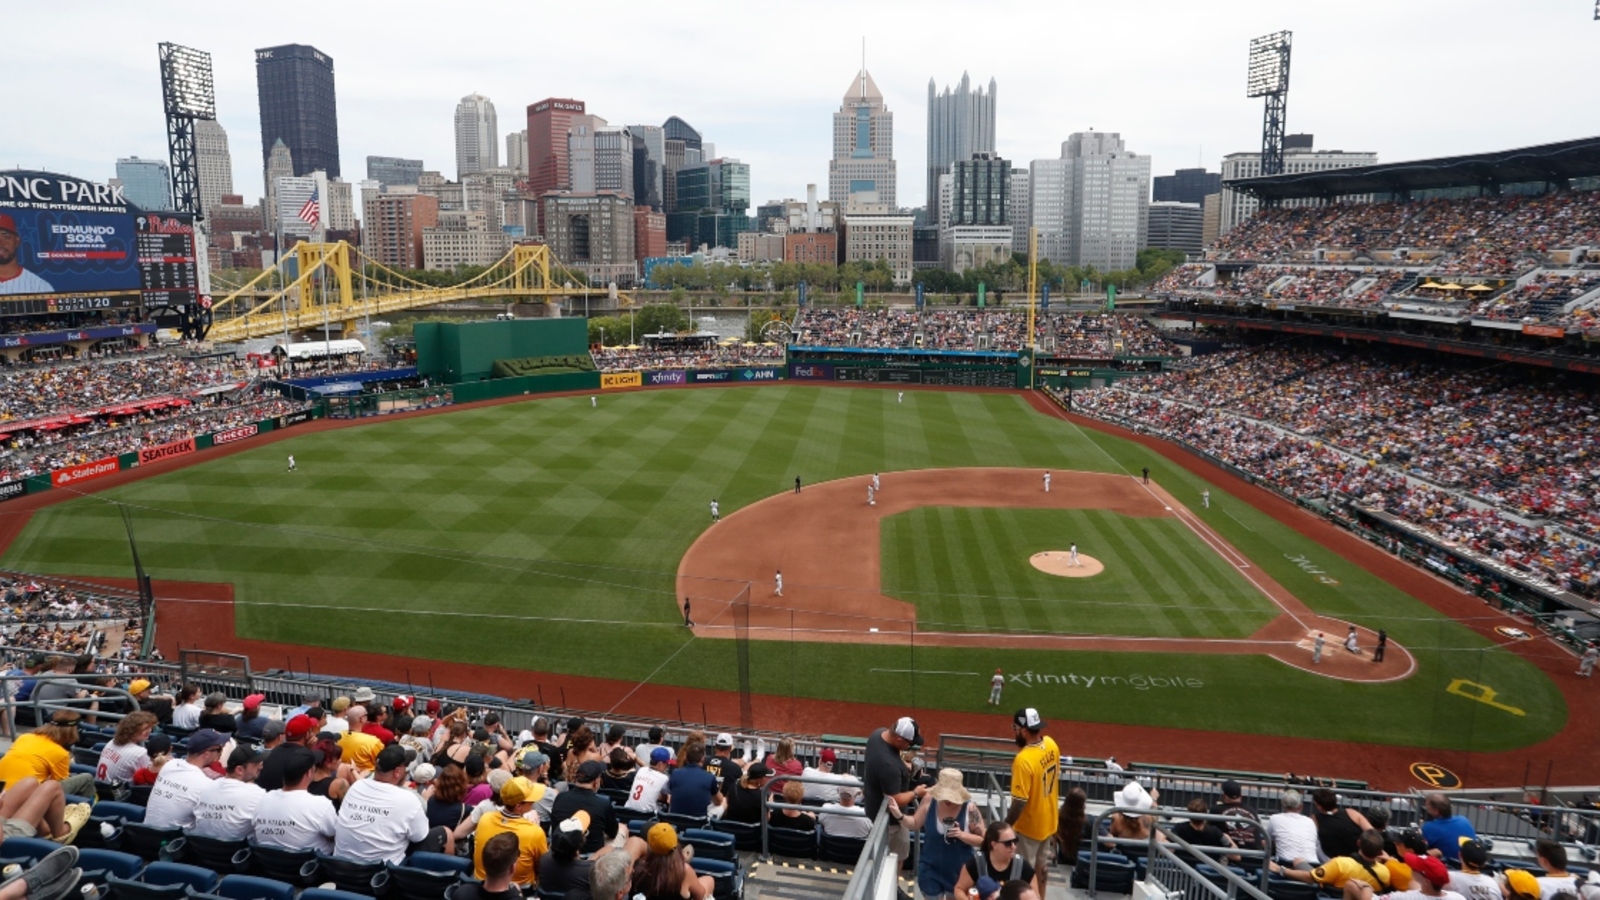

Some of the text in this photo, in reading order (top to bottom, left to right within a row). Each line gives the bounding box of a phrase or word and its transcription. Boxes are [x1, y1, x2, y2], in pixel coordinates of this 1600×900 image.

[57, 179, 127, 205] PARK
[49, 203, 97, 212] PITTSBURGH
[51, 225, 115, 235] EDMUNDO
[66, 233, 104, 243] SOSA
[122, 327, 141, 335] FedEx
[67, 332, 90, 341] FedEx
[5, 337, 30, 347] FedEx
[754, 370, 774, 379] AHN
[795, 366, 824, 377] FedEx
[615, 376, 638, 384] LIGHT
[651, 372, 682, 384] xfinity
[213, 424, 258, 445] SHEETZ
[142, 442, 192, 463] SEATGEEK
[1008, 671, 1097, 688] xfinity
[1043, 763, 1057, 798] 17
[632, 784, 644, 801] 3
